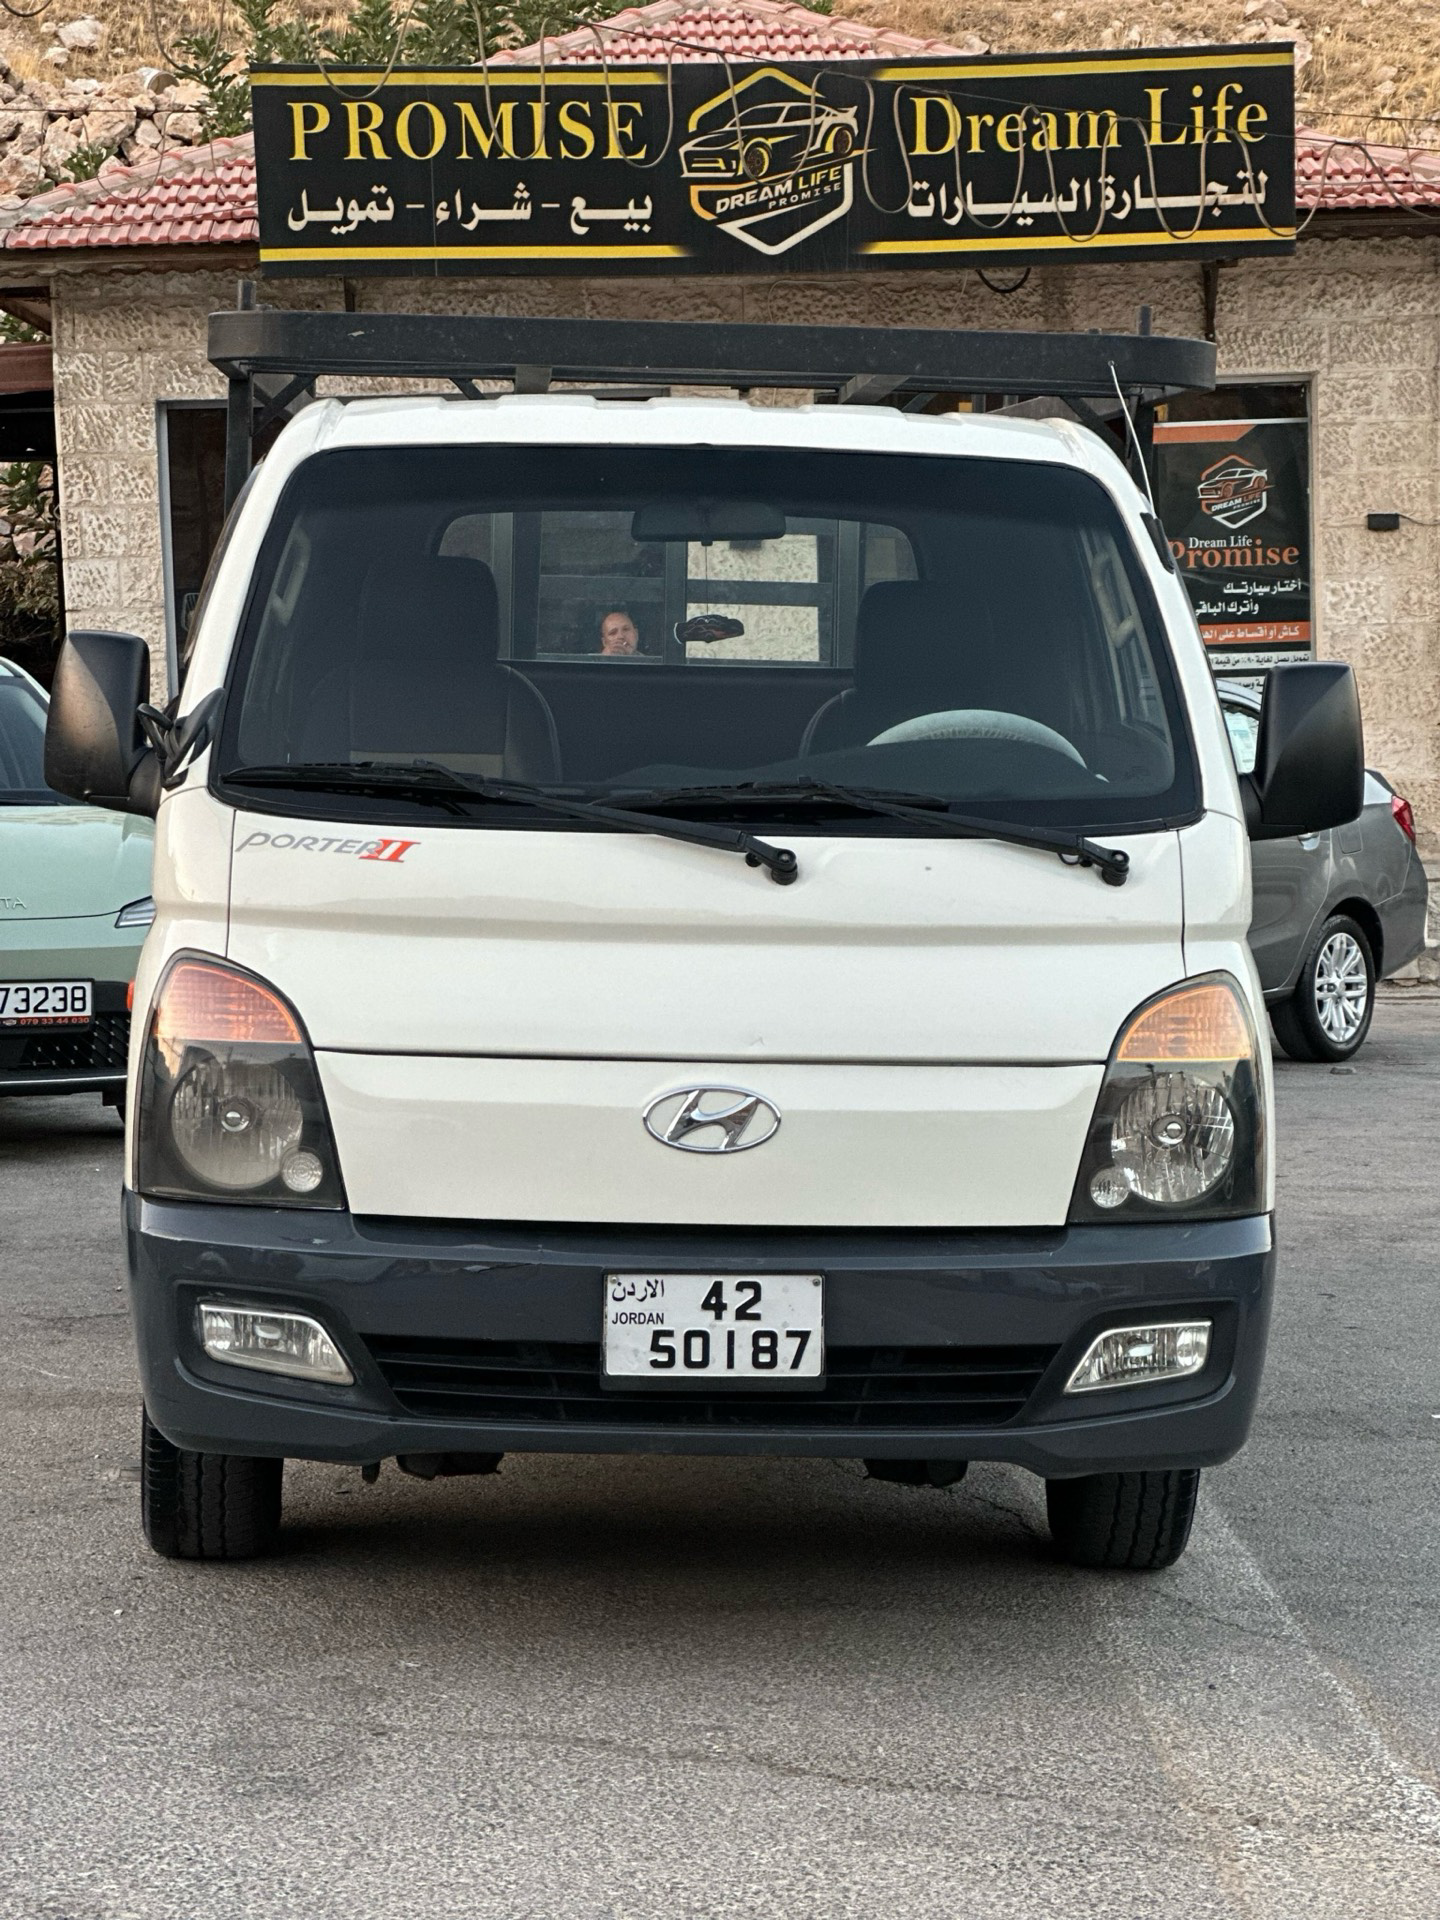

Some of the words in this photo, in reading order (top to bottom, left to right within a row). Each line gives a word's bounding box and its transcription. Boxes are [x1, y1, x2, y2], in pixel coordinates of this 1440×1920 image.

[286, 101, 647, 161] PROMISE
[908, 96, 1122, 156] Dream
[1144, 82, 1269, 146] Life
[287, 184, 395, 235] تمويل
[435, 182, 532, 231] شراء
[716, 179, 793, 213] DREAM
[798, 165, 842, 190] LIFE
[768, 182, 842, 209] PROMISE
[907, 177, 1092, 226] السيارات
[1101, 168, 1269, 219] لتجارة
[570, 194, 653, 235] بيع
[1211, 497, 1242, 512] DREAM
[1189, 537, 1227, 549] Dream
[1230, 535, 1253, 547] Life
[1223, 581, 1271, 596] سيارتك
[235, 831, 382, 855] PORTER
[611, 1279, 665, 1302] الاردن
[701, 1280, 762, 1321] 42
[611, 1312, 665, 1325] JORDAN
[649, 1329, 812, 1370] 50187
